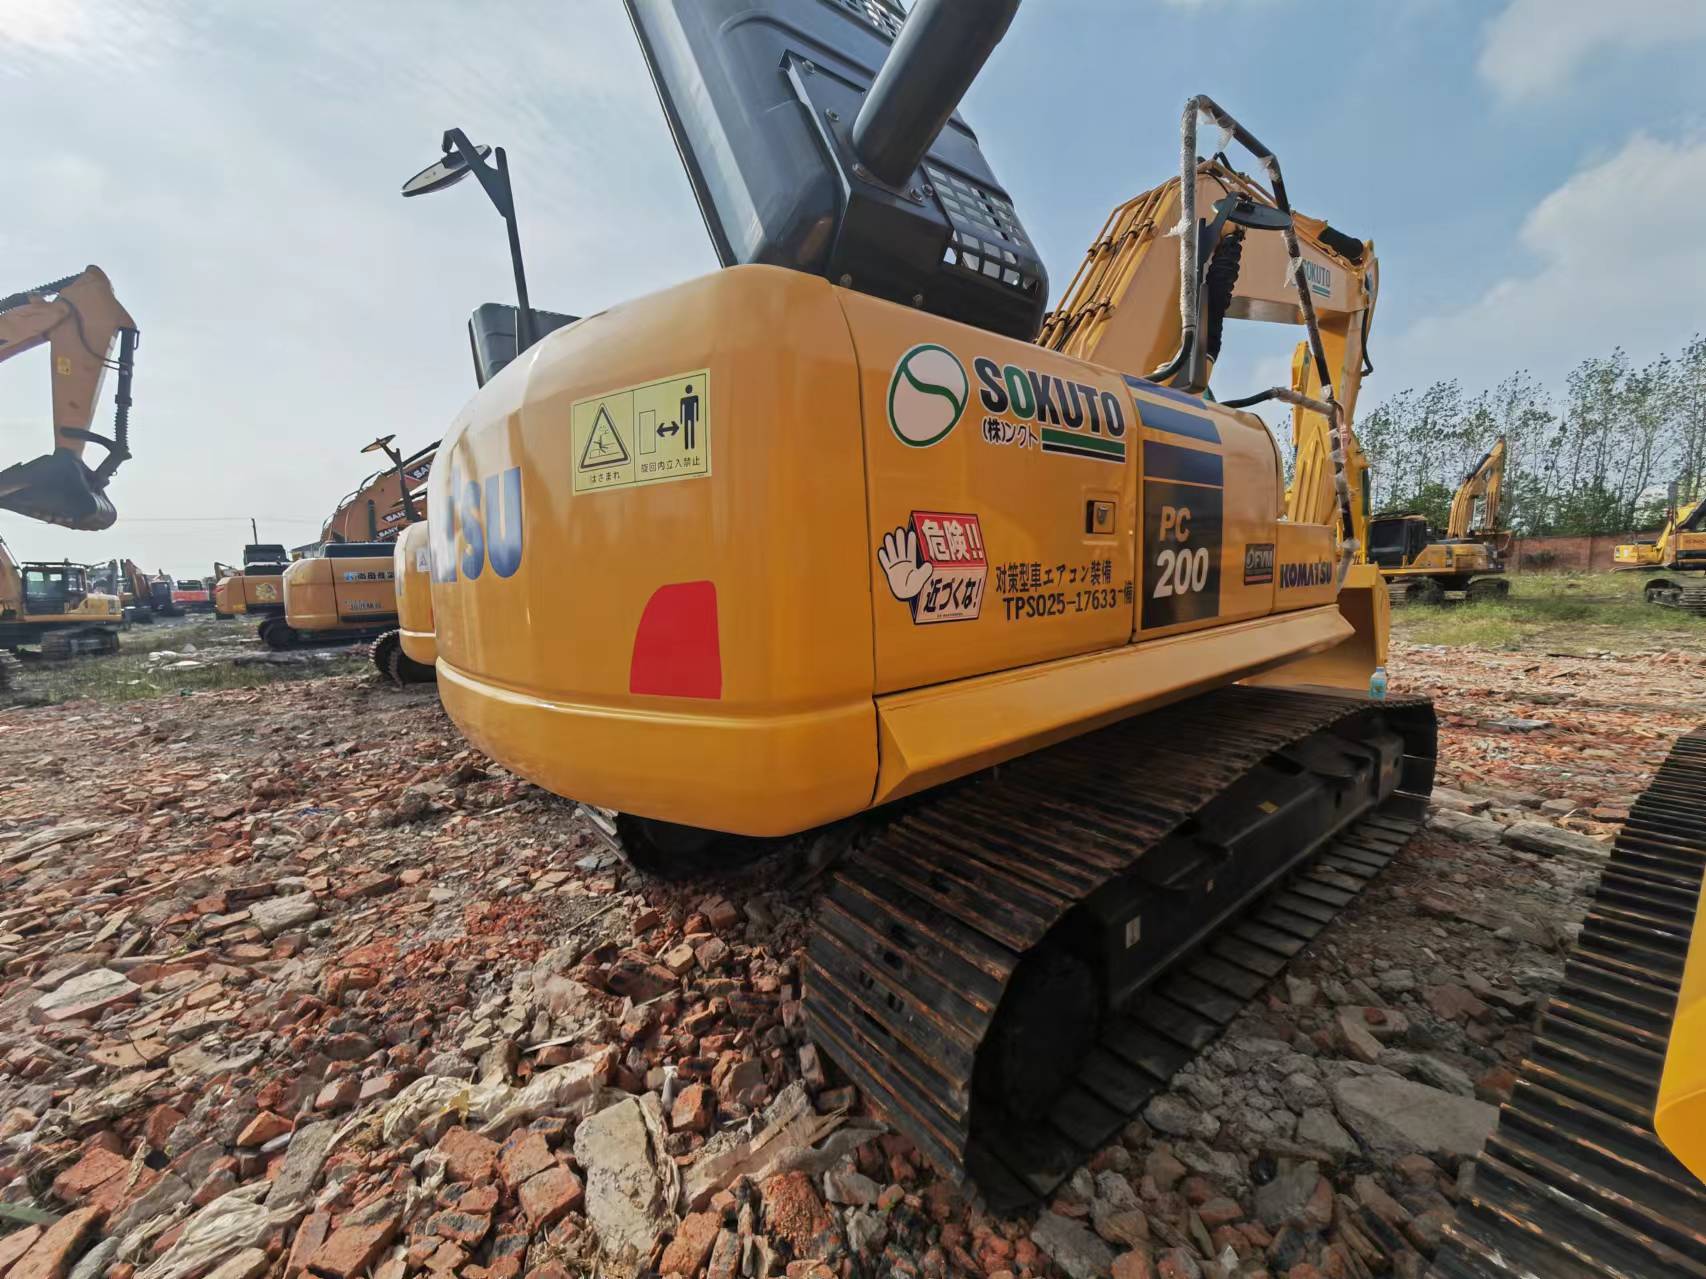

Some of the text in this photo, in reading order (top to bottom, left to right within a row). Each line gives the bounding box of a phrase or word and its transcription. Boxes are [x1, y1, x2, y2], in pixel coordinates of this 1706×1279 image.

[974, 357, 1125, 437] SOKUTO
[591, 471, 620, 483] はさまれ
[641, 456, 700, 473] 旋回内立入禁止
[1160, 505, 1191, 542] PC
[1153, 547, 1208, 598] 200
[1280, 561, 1332, 589] KOMATSU
